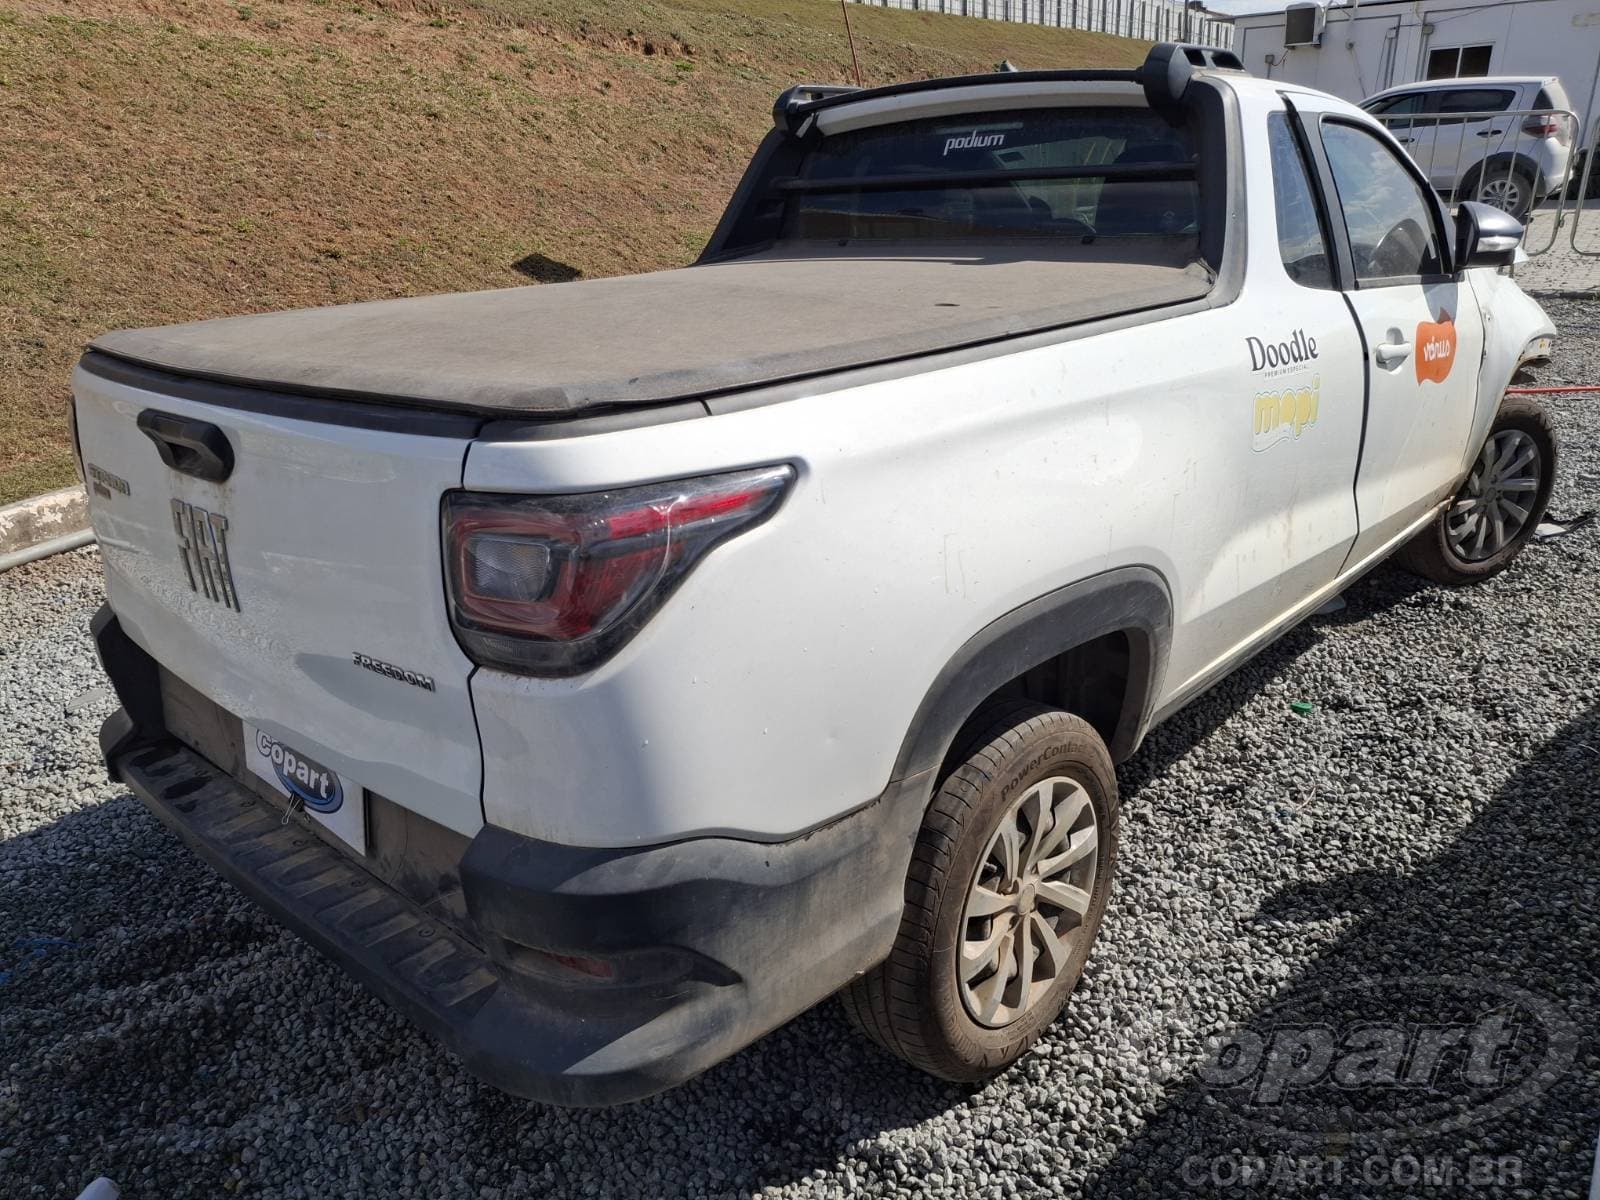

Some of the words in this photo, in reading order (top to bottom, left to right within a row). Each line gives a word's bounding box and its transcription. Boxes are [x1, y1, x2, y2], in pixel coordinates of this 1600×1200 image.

[943, 130, 1005, 156] podium
[1245, 328, 1319, 371] Doodle
[169, 498, 241, 613] FIAT
[352, 651, 436, 693] FREEDOM
[256, 729, 330, 800] Copart
